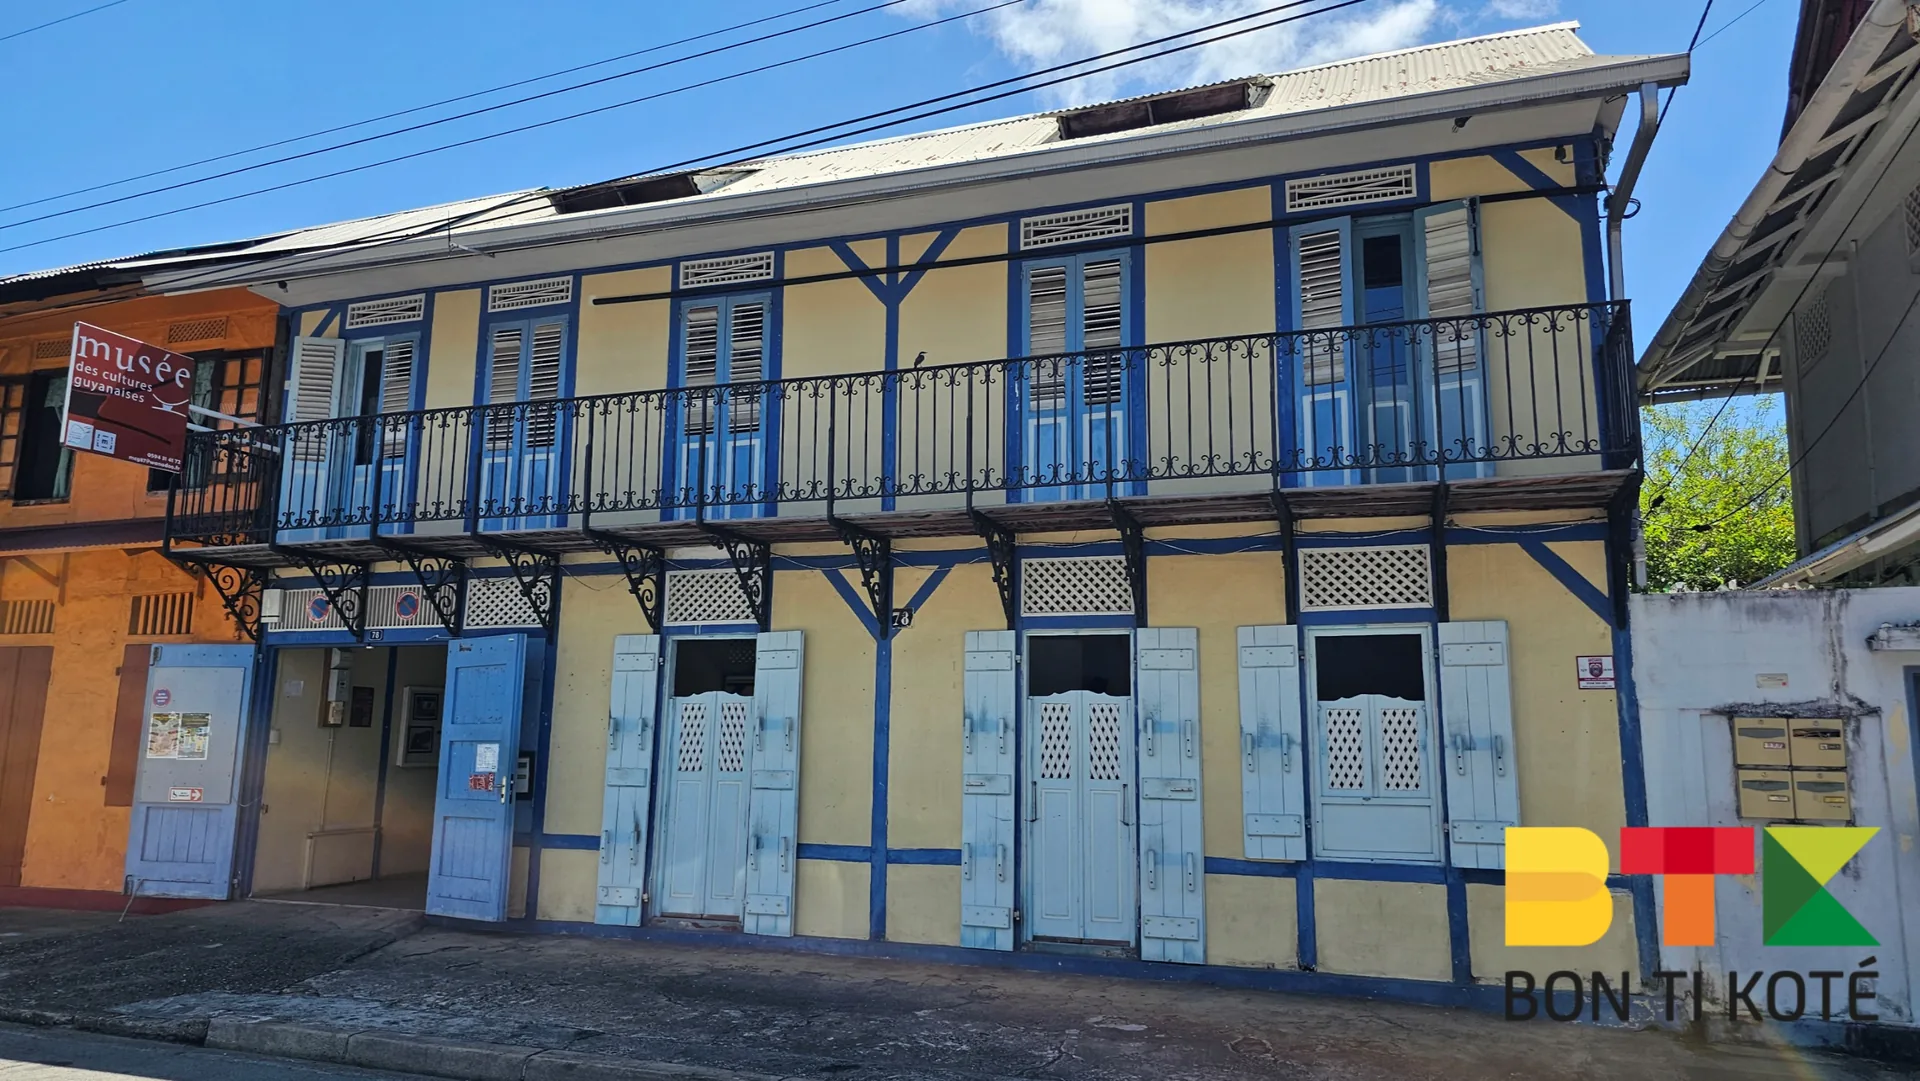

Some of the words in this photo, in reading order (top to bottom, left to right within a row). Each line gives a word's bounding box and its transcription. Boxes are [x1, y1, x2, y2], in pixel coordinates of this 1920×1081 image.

[77, 335, 191, 388] musée
[74, 376, 145, 403] guyanaises
[75, 361, 98, 376] des
[102, 371, 153, 392] cultures
[891, 611, 910, 626] 78
[371, 631, 380, 639] 78
